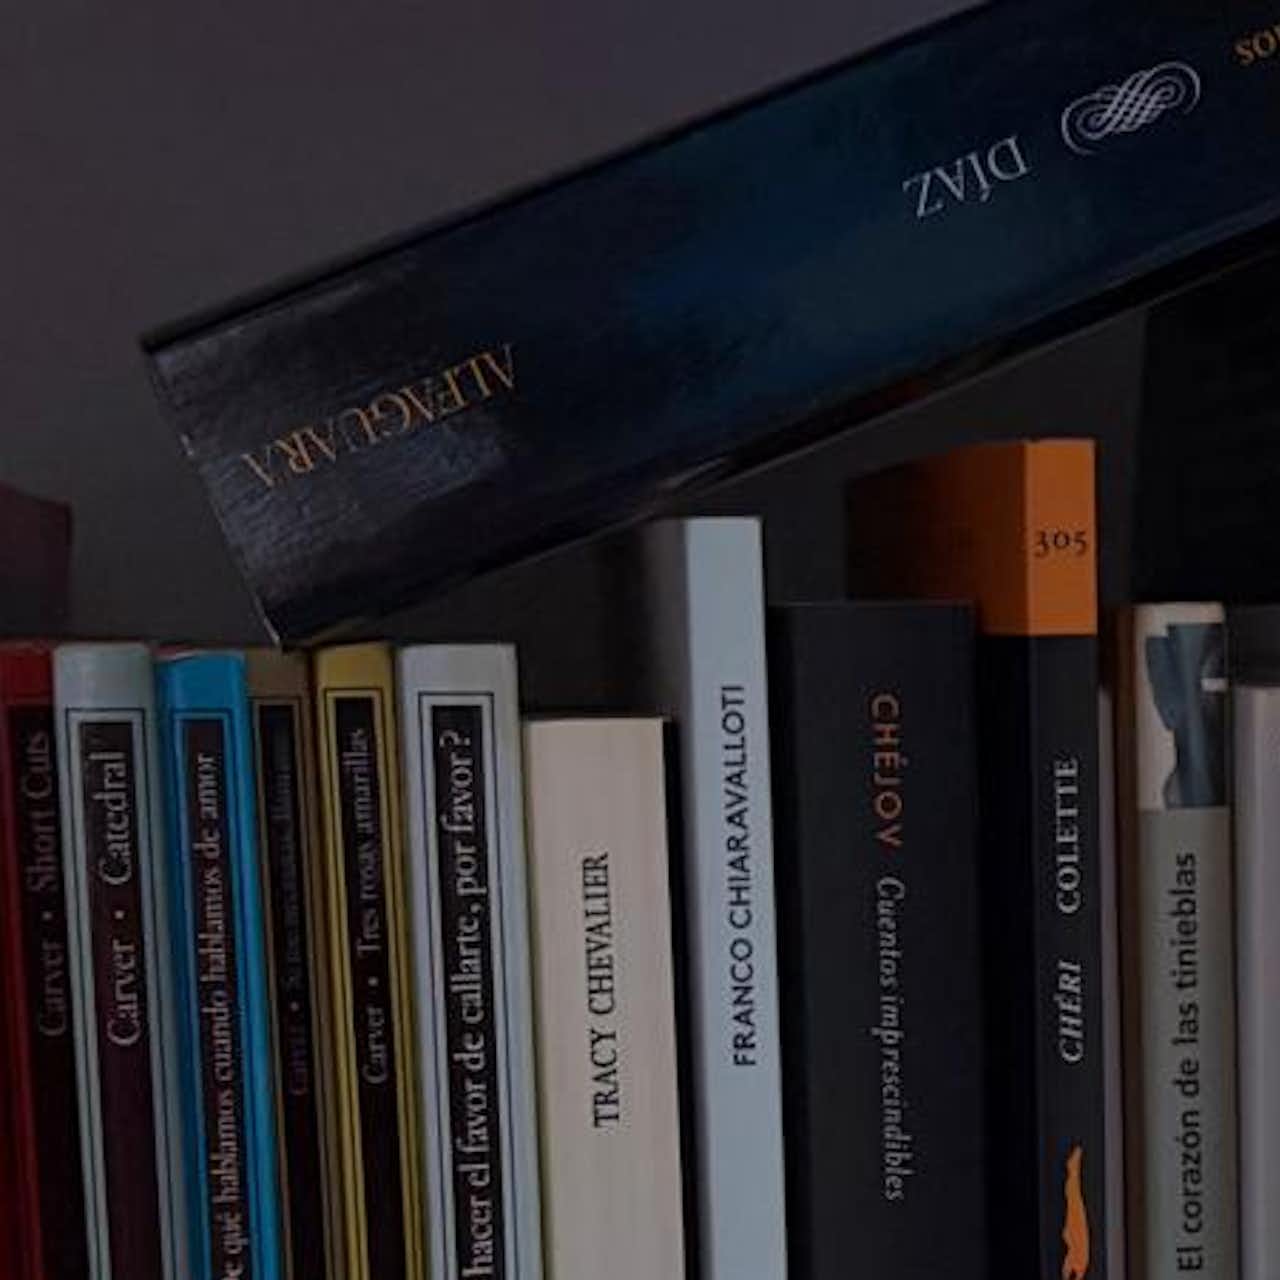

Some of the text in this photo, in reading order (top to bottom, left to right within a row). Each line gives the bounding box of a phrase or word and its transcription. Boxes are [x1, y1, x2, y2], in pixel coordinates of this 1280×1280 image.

[901, 136, 1031, 217] DÍAZ
[241, 342, 518, 488] ALFAGUARA
[1034, 530, 1087, 558] 305
[196, 751, 219, 820] amor
[871, 693, 908, 850] CHÉJOV
[195, 826, 221, 859] de
[450, 842, 487, 895] por
[720, 684, 756, 1067] FRANCO CHIARAVALLOTI
[1052, 757, 1081, 914] COLETTE
[89, 750, 142, 1046] Carver Catedral
[197, 866, 226, 982] hablamos
[1168, 853, 1199, 989] tinieblas
[582, 852, 620, 1128] TRACY CHEVALIER
[1051, 959, 1084, 1063] CHÉRI
[1171, 1002, 1200, 1046] las
[200, 990, 233, 1083] cuando
[361, 1005, 390, 1086] Carver
[454, 1032, 486, 1070] de
[871, 876, 916, 1201] Cuentos imprescindibles
[1172, 1059, 1201, 1097] de
[208, 1088, 240, 1203] hablamos
[455, 1078, 490, 1153] favor
[455, 1163, 490, 1186] el
[1173, 1110, 1203, 1233] corazón
[461, 1193, 496, 1277] hacer
[1176, 1244, 1204, 1272] El
